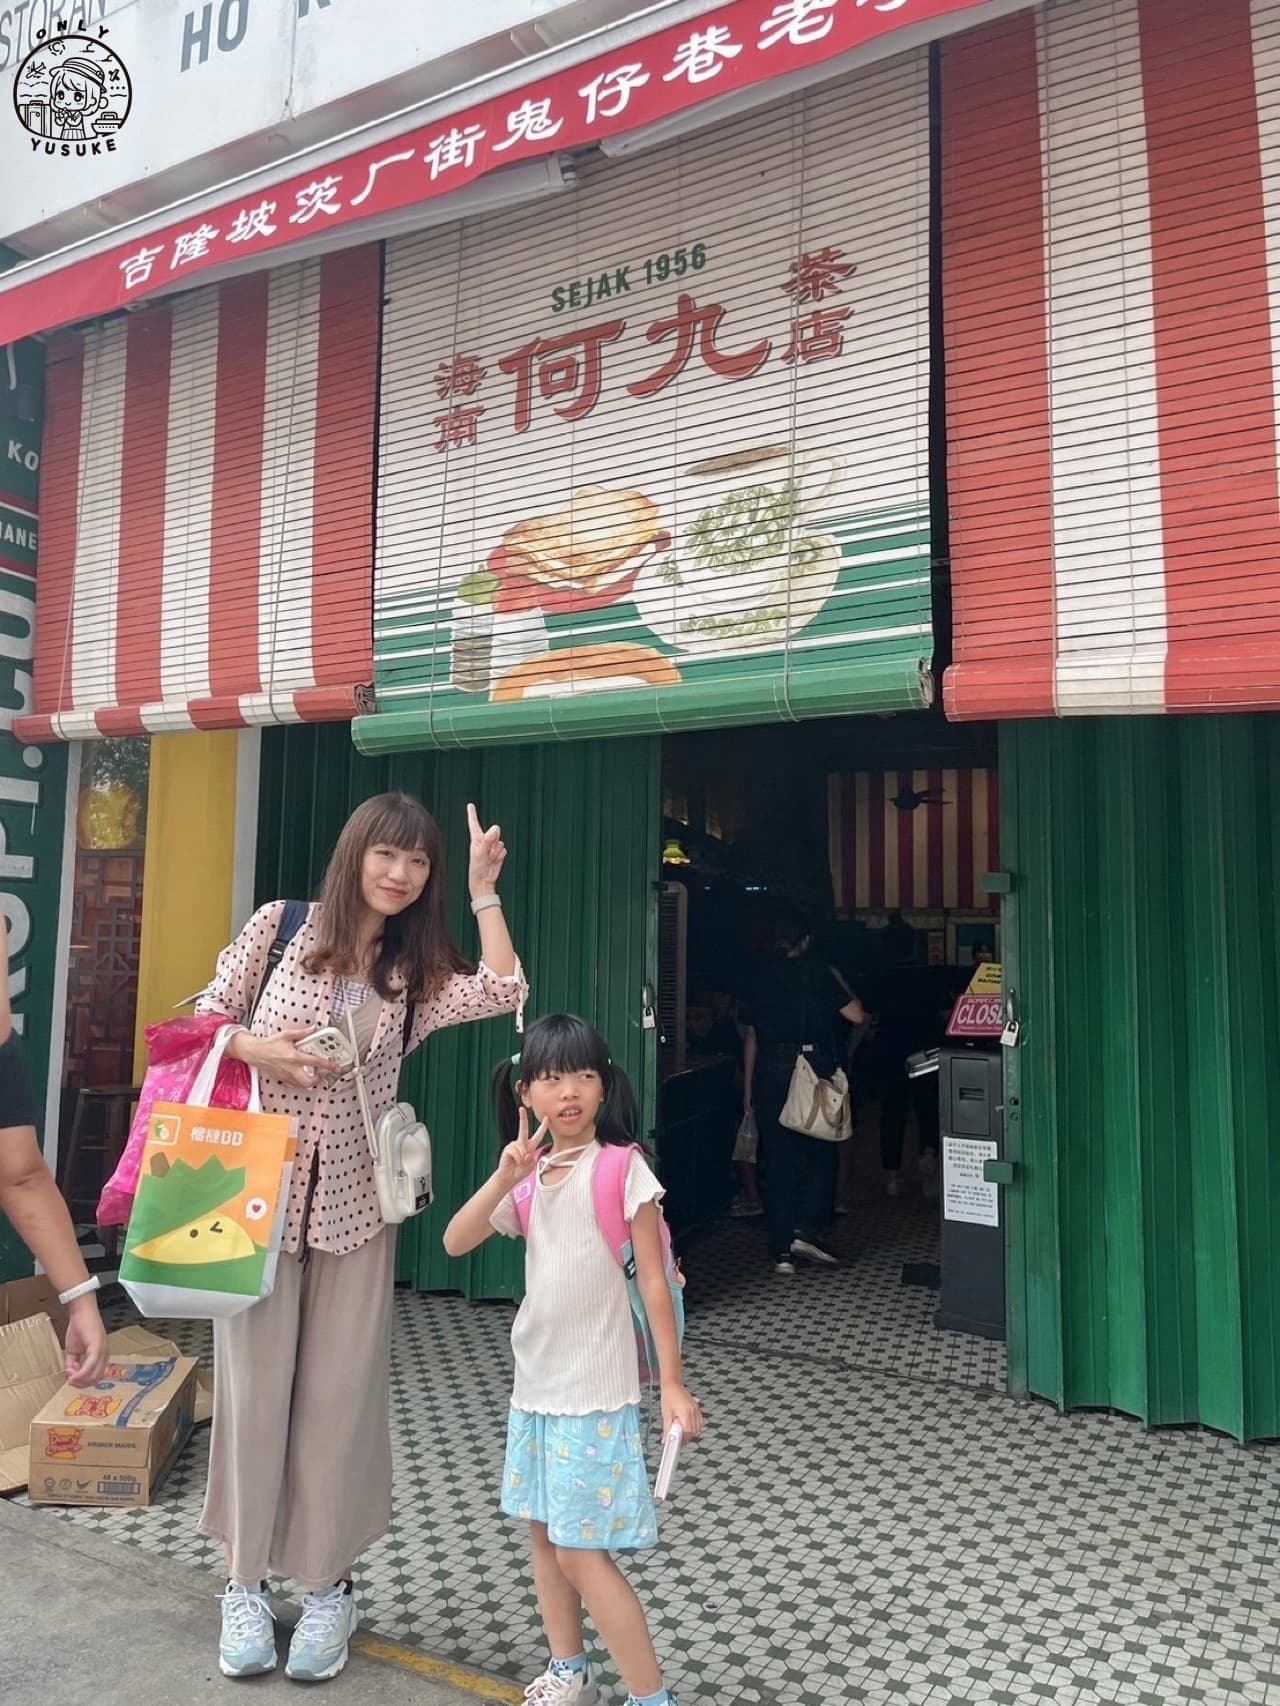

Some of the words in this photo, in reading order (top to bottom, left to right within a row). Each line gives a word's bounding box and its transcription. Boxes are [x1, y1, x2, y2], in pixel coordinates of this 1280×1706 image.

[180, 0, 249, 73] HO
[119, 0, 908, 290] 吉隆坡茨厂街鬼仔巷老
[551, 265, 631, 313] SEJAK
[643, 243, 708, 286] 1956
[957, 1003, 1003, 1025] CLOS
